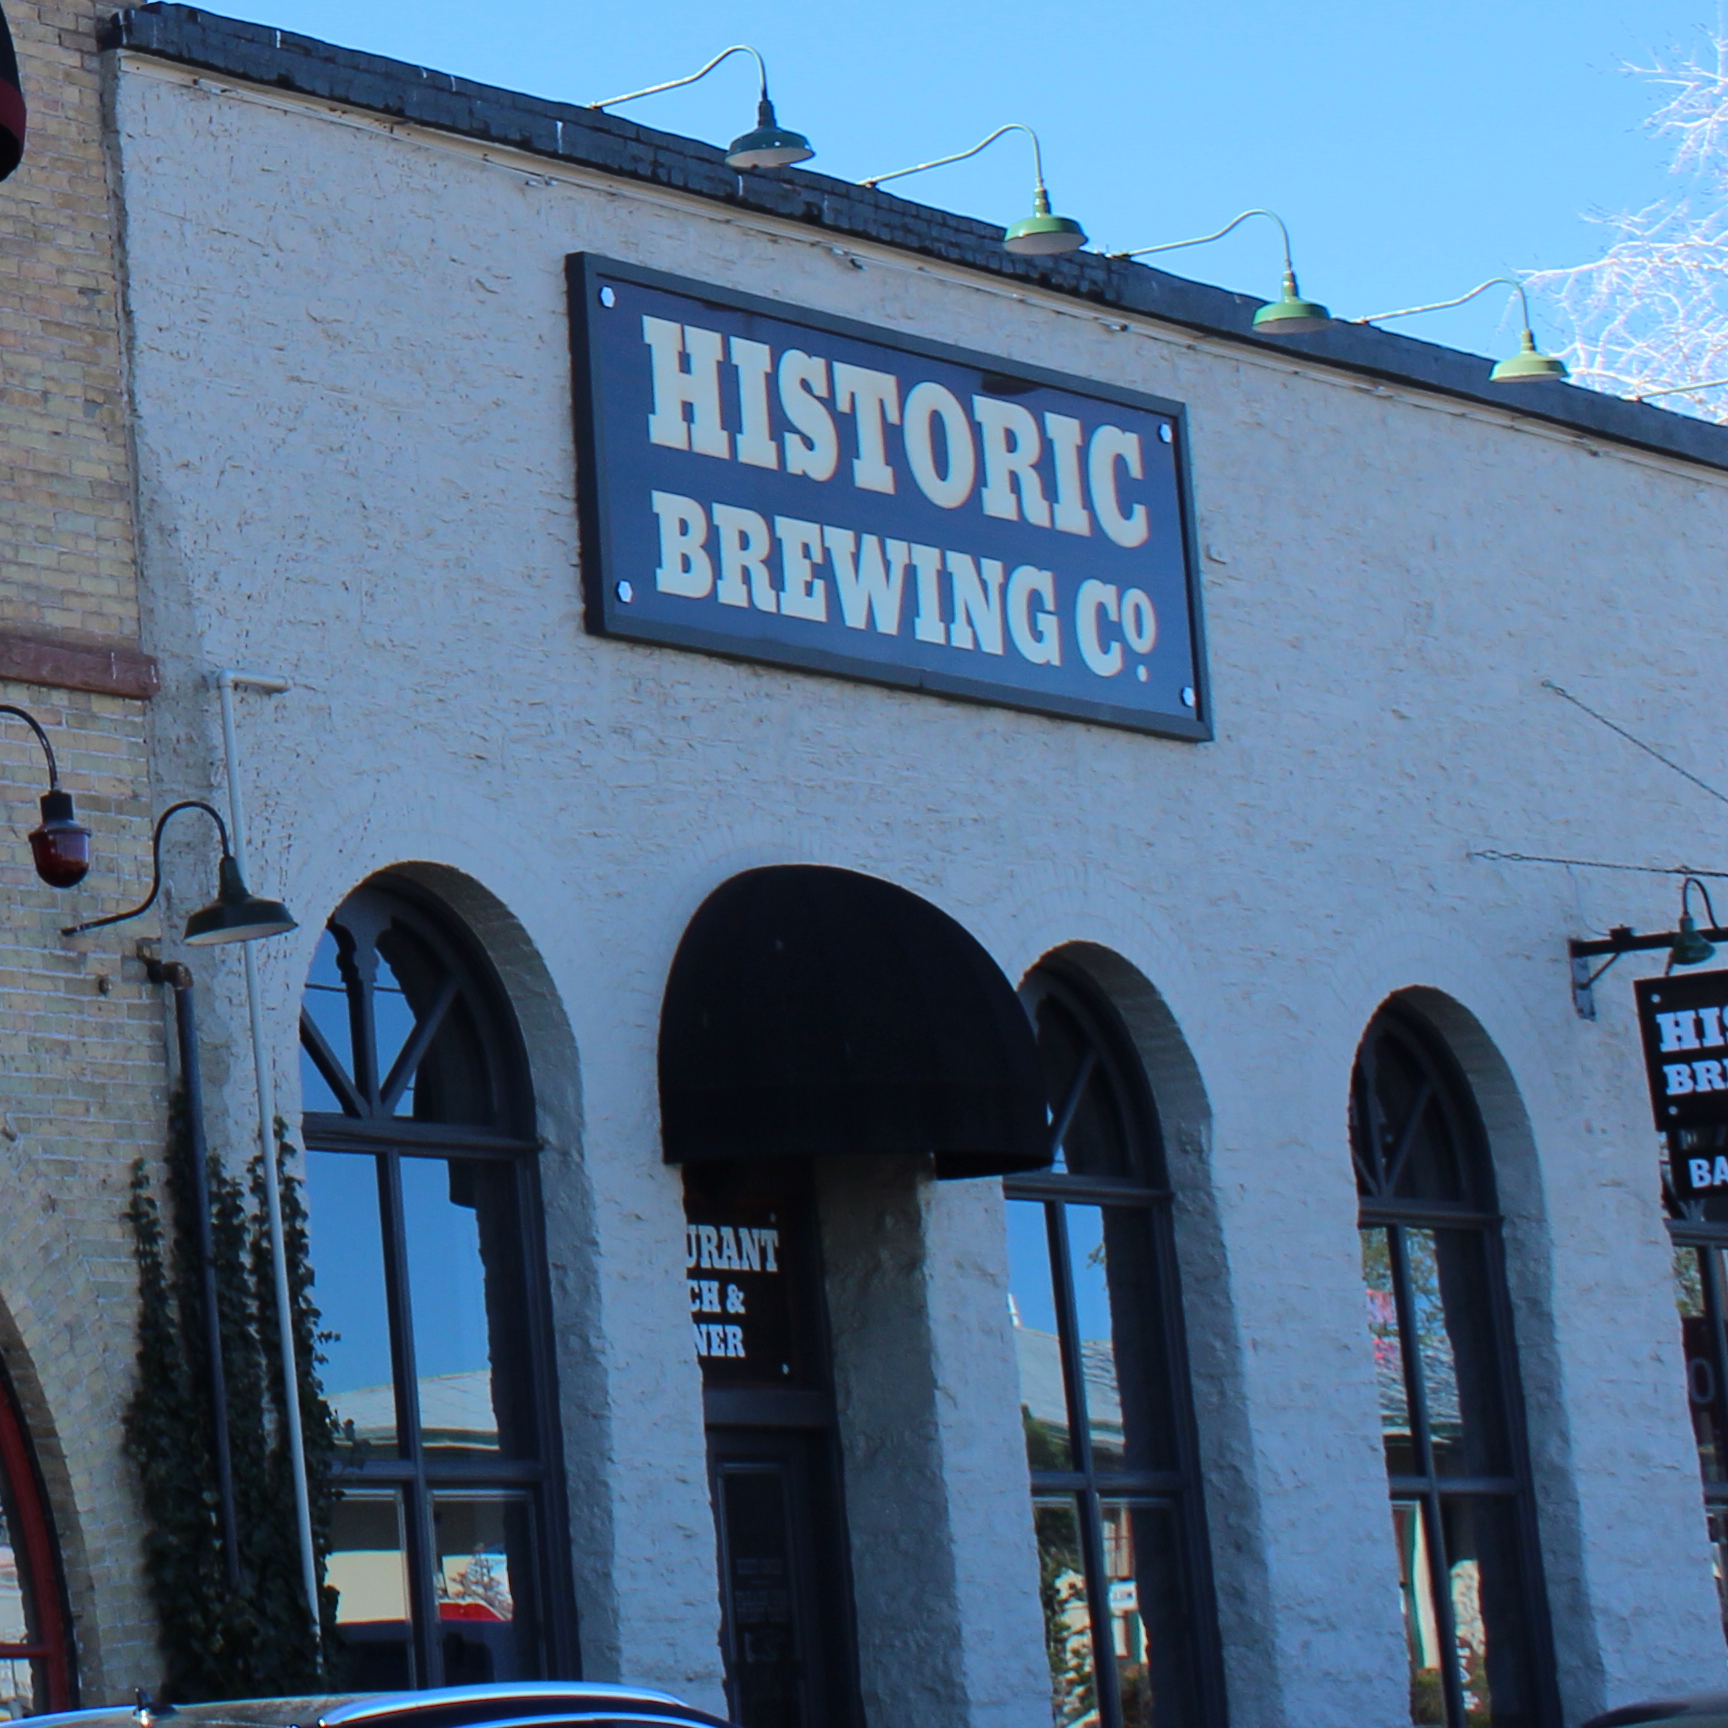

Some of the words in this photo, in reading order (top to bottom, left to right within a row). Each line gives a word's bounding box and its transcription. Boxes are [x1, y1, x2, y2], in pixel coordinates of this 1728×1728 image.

[642, 314, 1150, 549] HISTORIC
[650, 489, 1062, 667] BREWING
[726, 1283, 747, 1314] &
